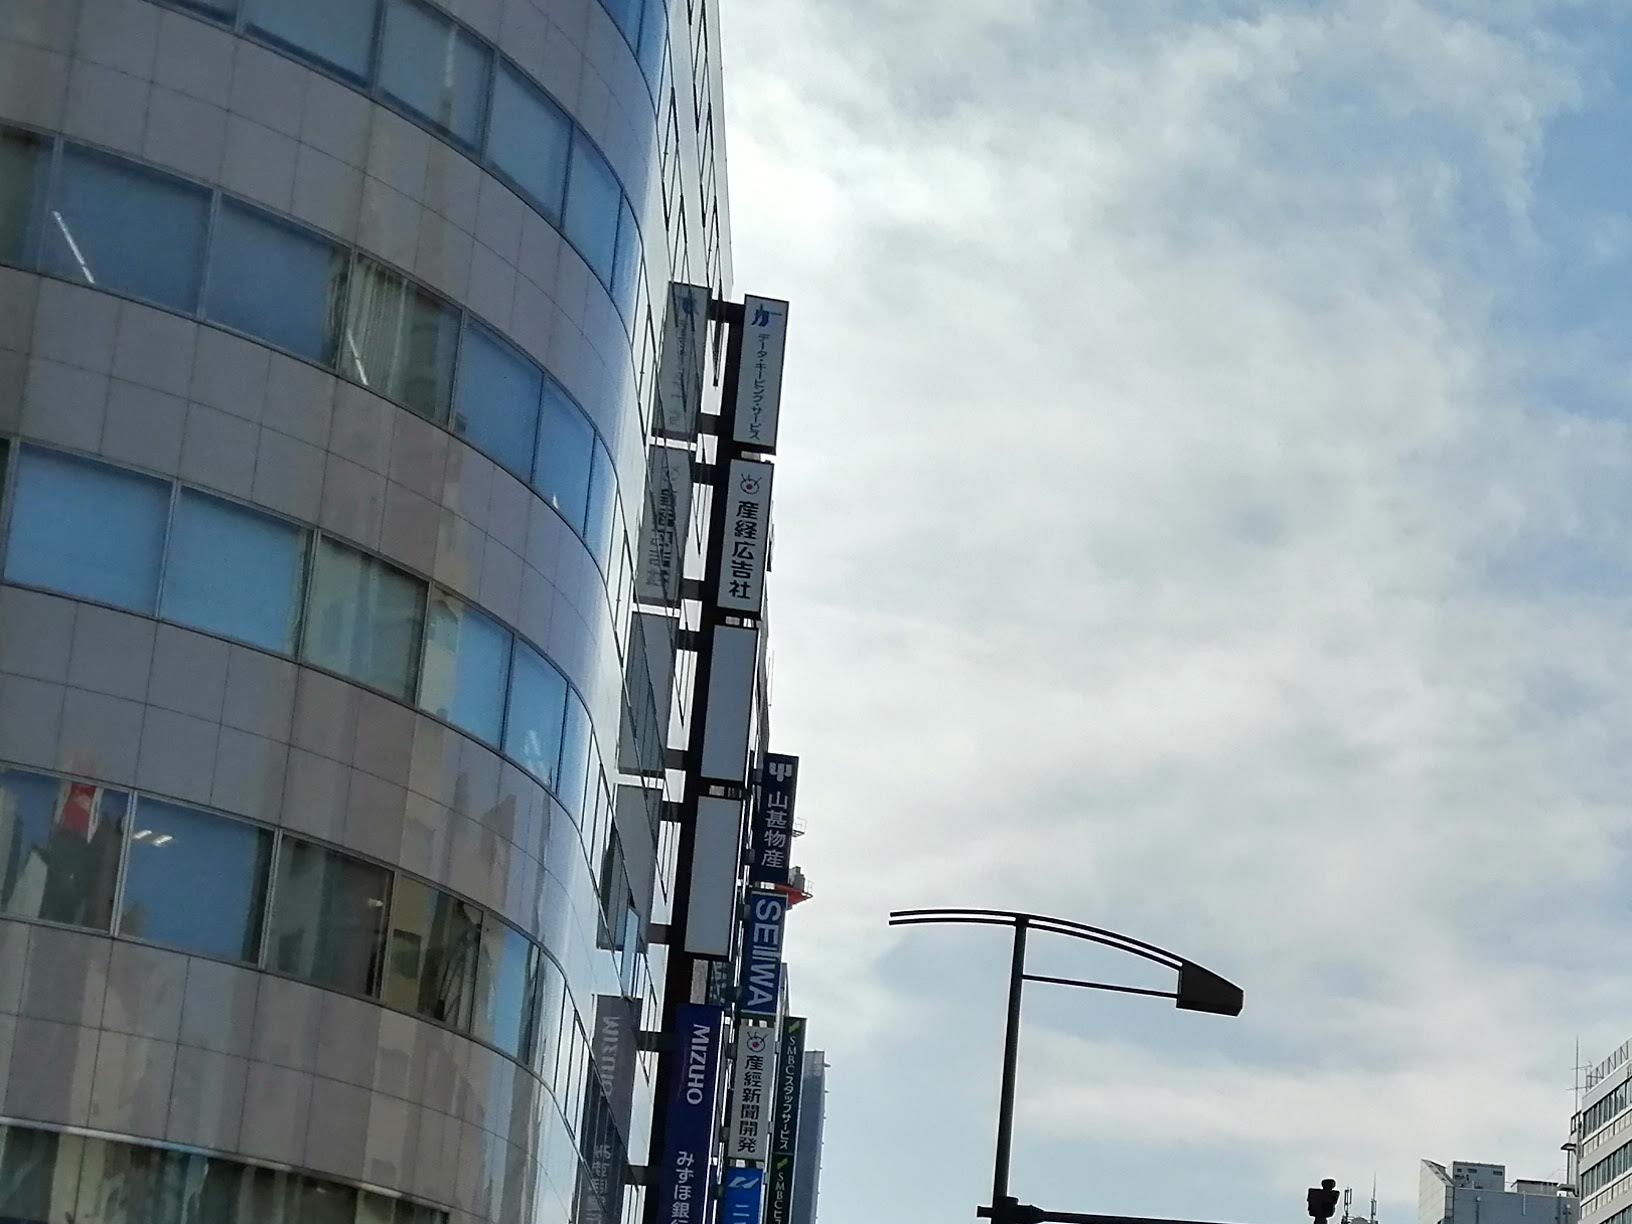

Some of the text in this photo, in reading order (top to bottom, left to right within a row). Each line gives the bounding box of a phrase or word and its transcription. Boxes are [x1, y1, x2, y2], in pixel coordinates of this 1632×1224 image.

[729, 500, 759, 600] 産経広告社
[761, 791, 788, 868] 山甚物産
[747, 898, 782, 1006] SEIWA
[686, 1023, 711, 1105] MIZUHO
[780, 1036, 797, 1150] SMBCスタッフサービス
